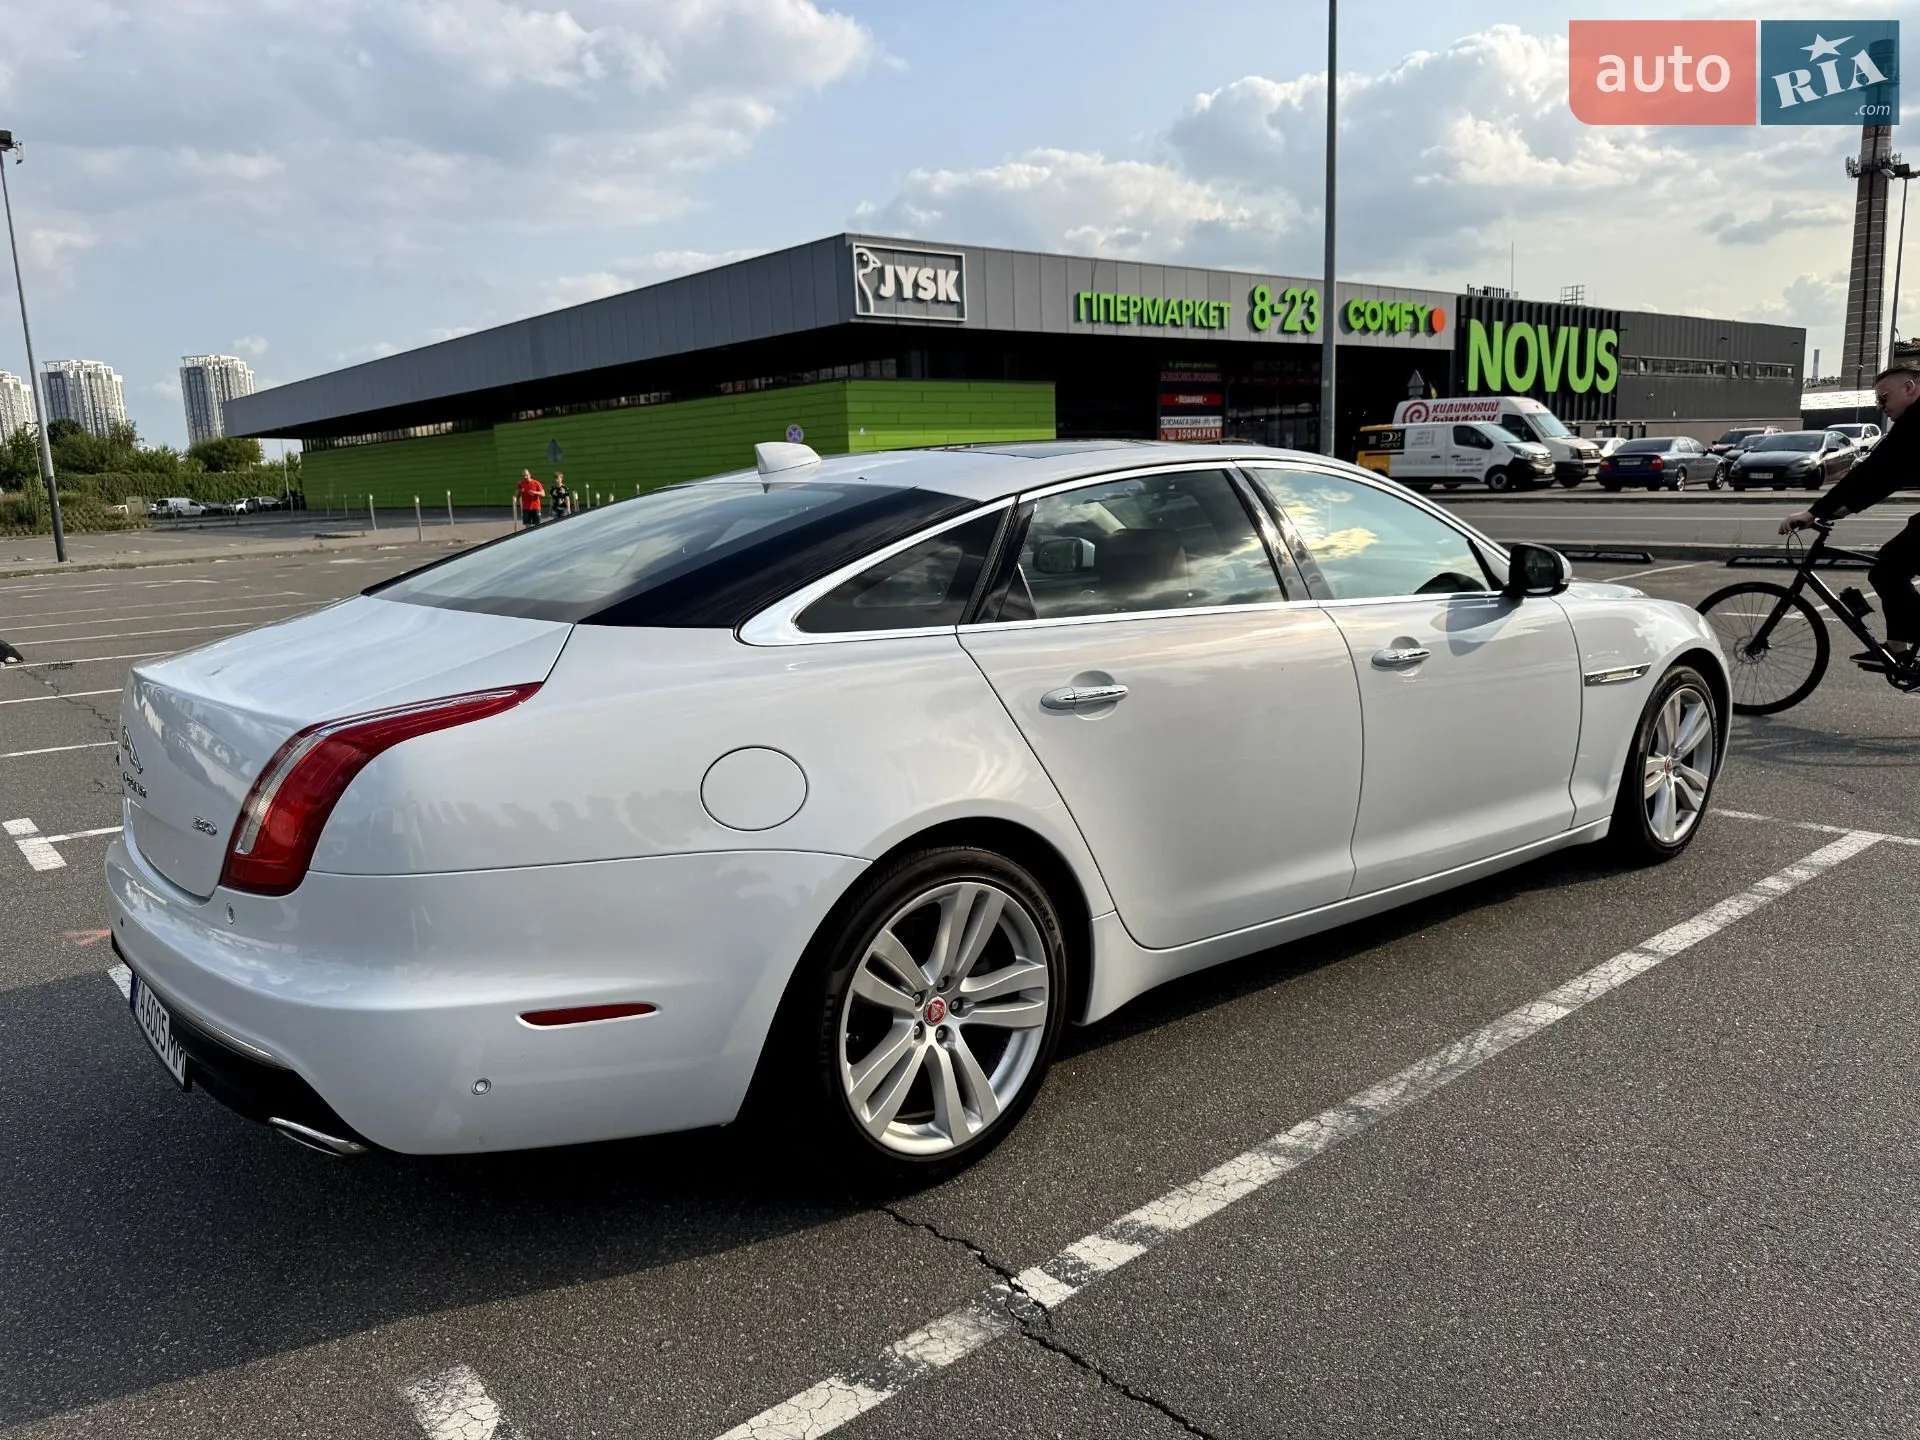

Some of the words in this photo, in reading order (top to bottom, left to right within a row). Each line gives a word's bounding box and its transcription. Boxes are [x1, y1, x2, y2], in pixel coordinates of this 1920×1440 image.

[878, 265, 961, 303] JYSK
[1077, 292, 1231, 330] ГІПЕРМАРКЕТ
[1252, 285, 1320, 333] 8-23
[1347, 297, 1430, 334] COMFY
[1467, 319, 1618, 393] NOVUS
[1178, 429, 1220, 440] ЗООМАРКЕТ
[145, 993, 167, 1052] 6005
[167, 1032, 186, 1078] MM
